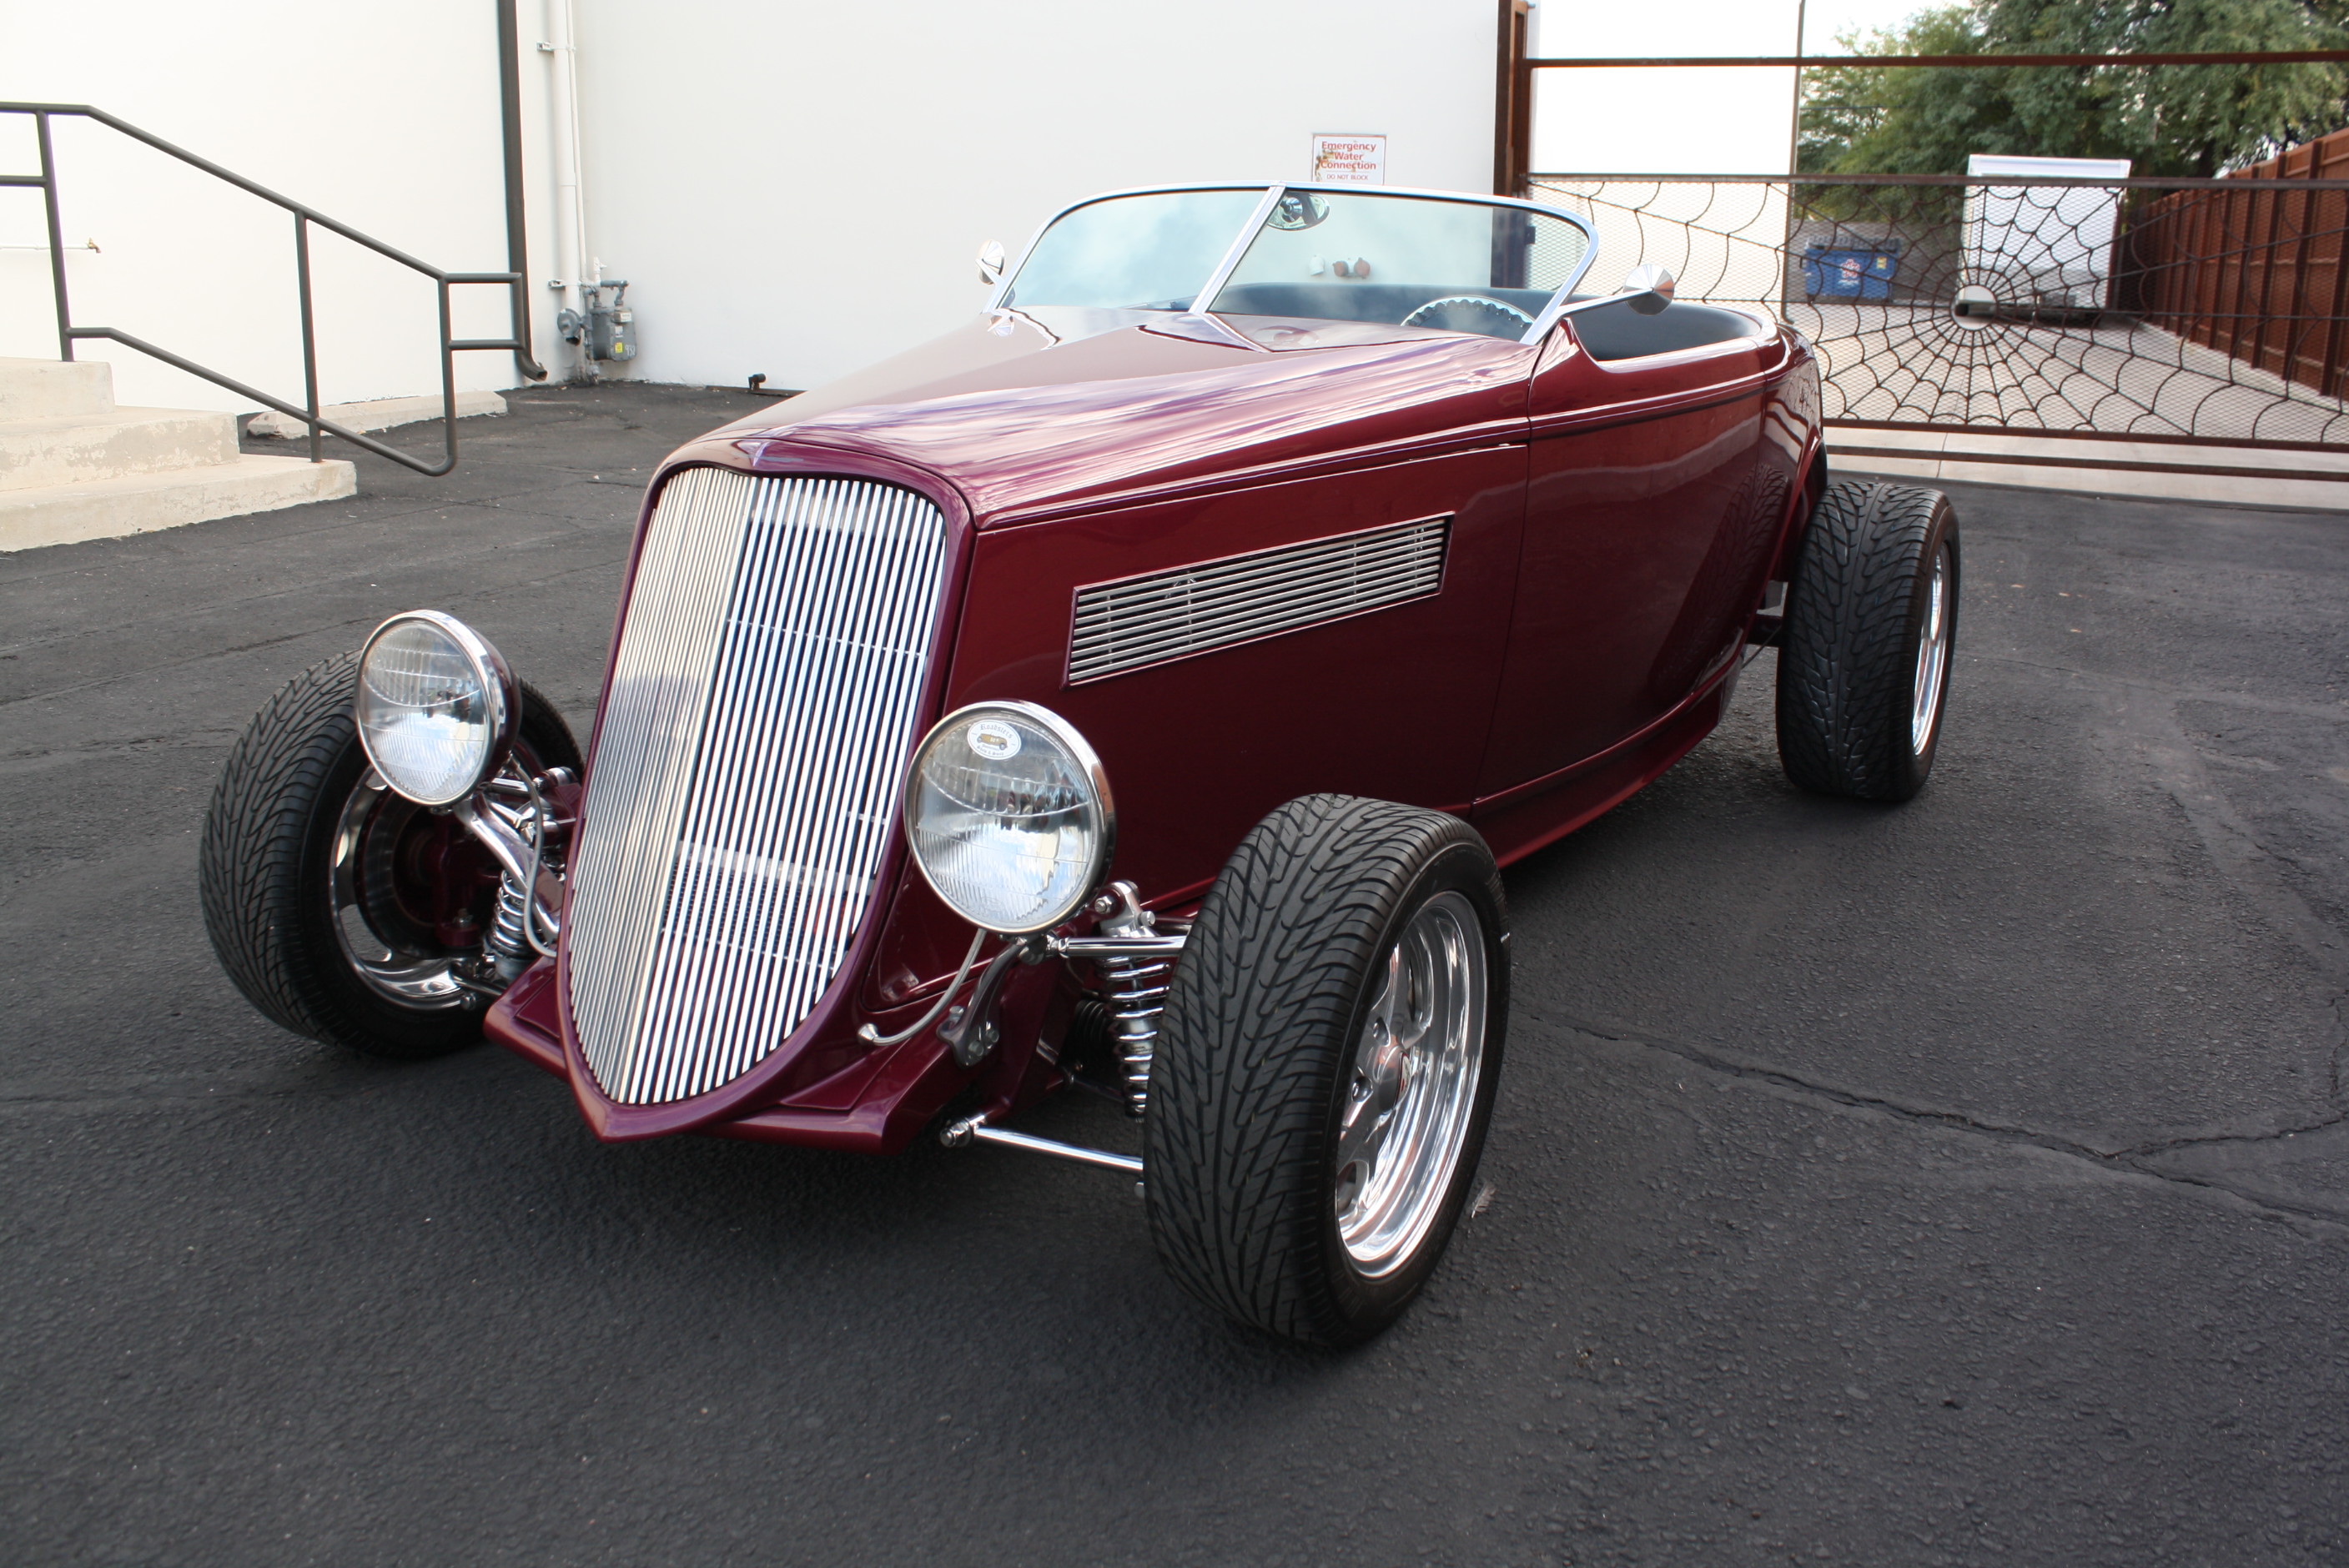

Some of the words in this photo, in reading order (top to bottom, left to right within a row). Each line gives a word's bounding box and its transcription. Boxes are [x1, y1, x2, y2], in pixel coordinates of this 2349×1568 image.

[1321, 141, 1376, 153] Emergency
[1334, 152, 1364, 160] Water
[1320, 160, 1376, 169] Connection
[980, 724, 1013, 739] Roadsters
